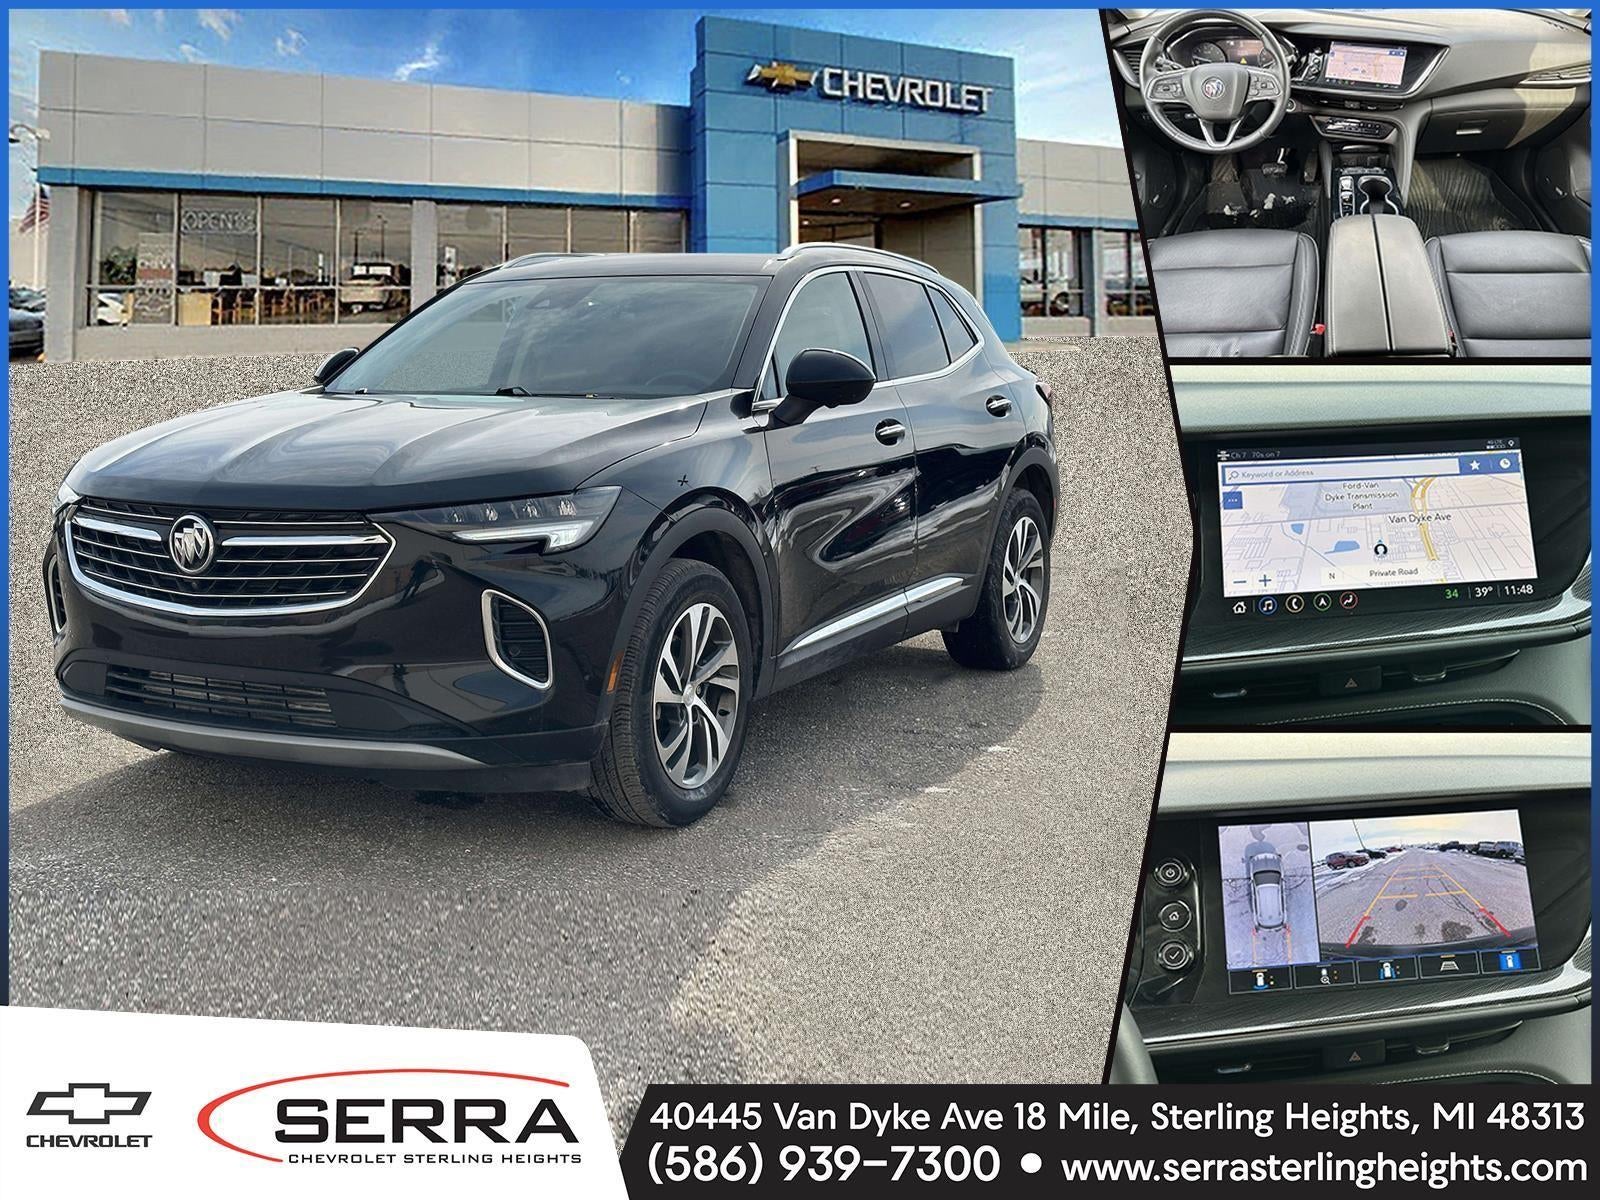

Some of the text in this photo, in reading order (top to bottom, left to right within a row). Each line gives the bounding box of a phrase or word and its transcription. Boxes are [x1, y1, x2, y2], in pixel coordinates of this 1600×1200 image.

[822, 67, 994, 112] CHEVROLET
[1241, 471, 1273, 480] Keyword
[1325, 491, 1399, 502] Dyke Transmission
[1352, 502, 1373, 510] Plant
[1388, 512, 1452, 525] Van Dyke Ave
[1369, 569, 1396, 577] Private
[1445, 588, 1459, 599] 34
[1504, 584, 1534, 595] 11:48
